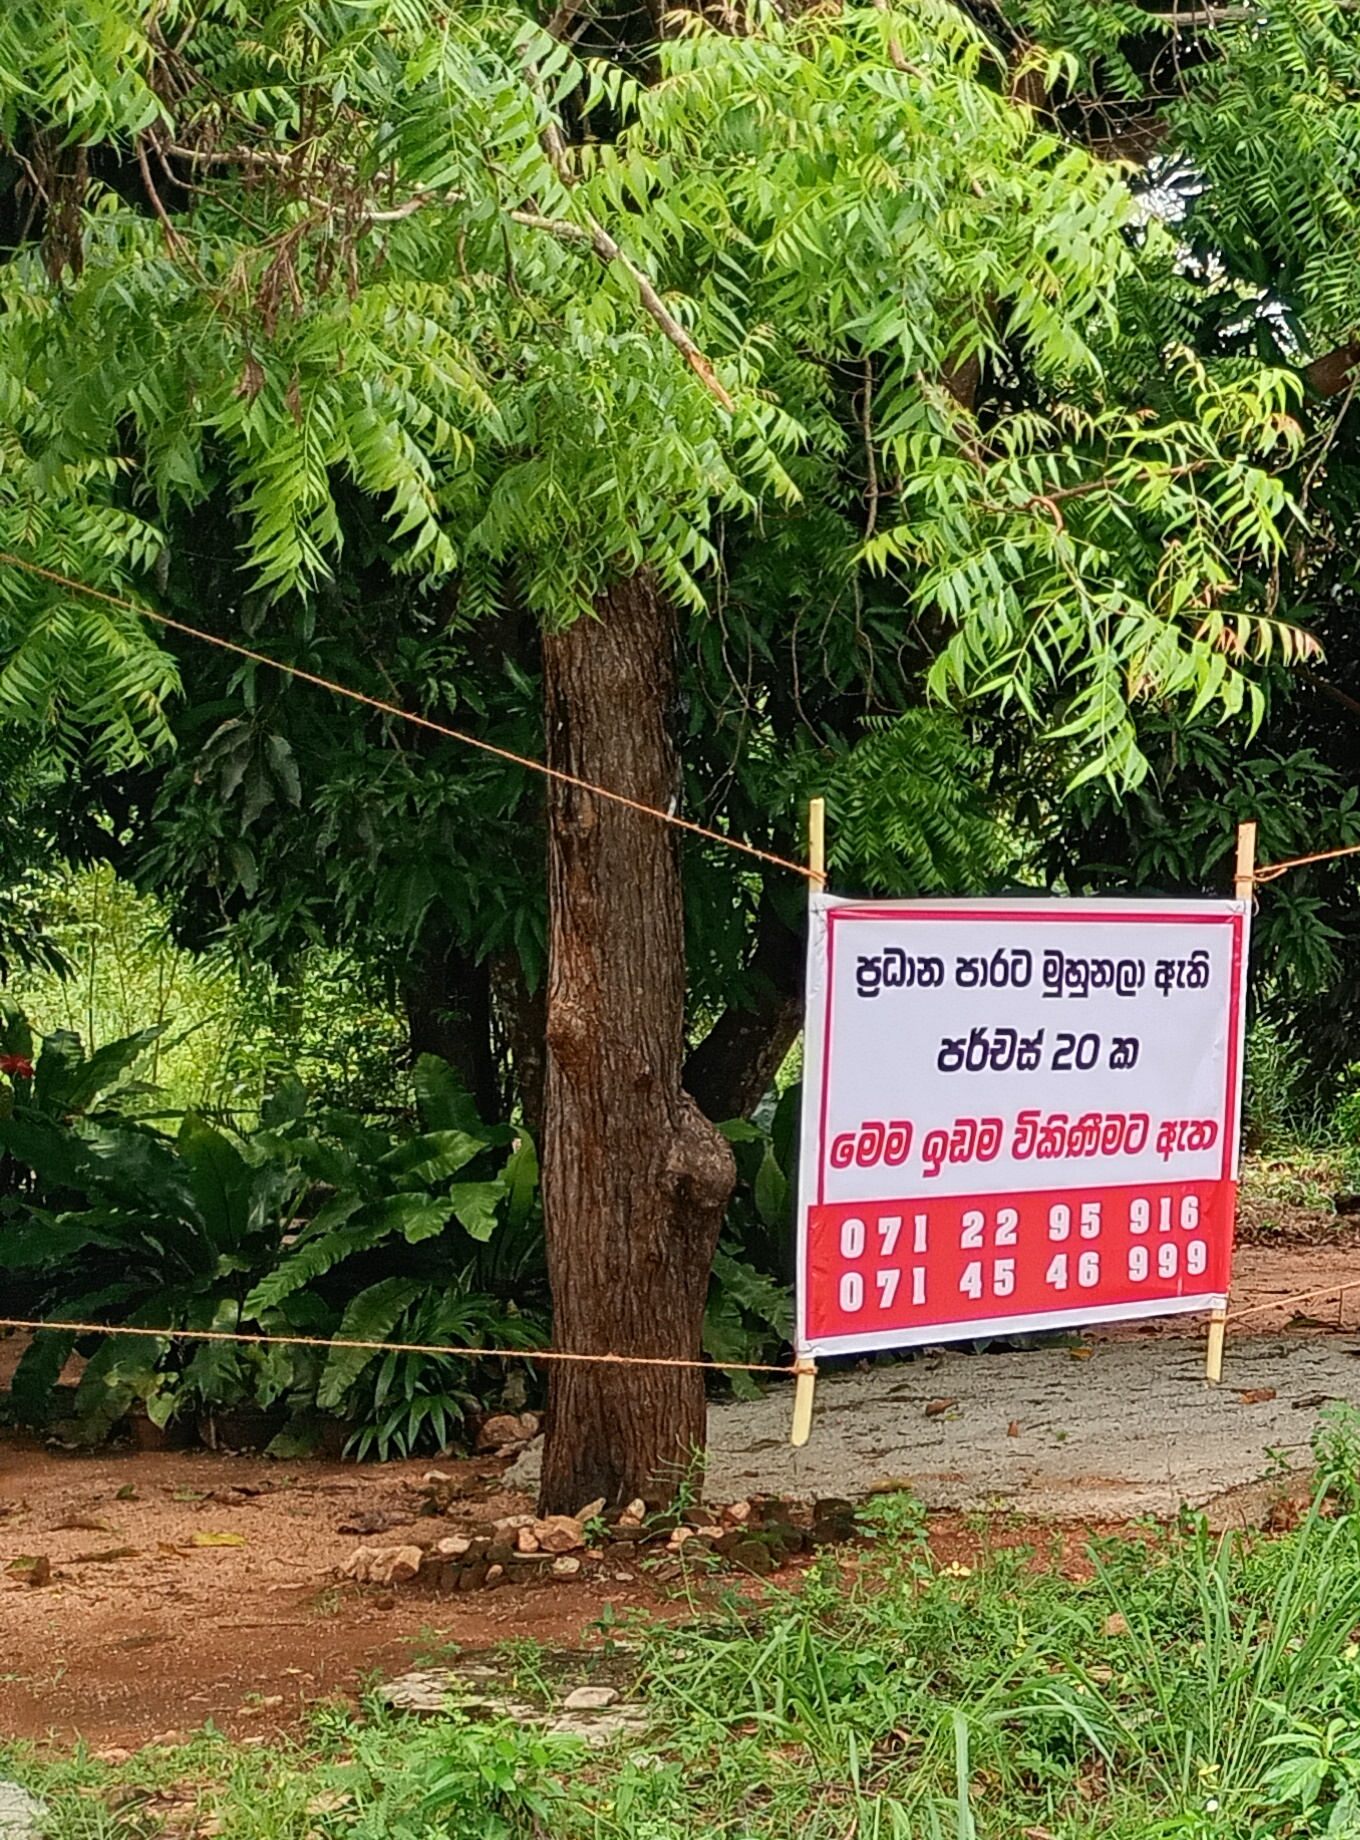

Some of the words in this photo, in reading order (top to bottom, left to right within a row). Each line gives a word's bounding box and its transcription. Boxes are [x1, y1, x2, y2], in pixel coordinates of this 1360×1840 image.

[856, 947, 945, 998] ප්‍රධාන
[955, 947, 1033, 988] පාරට
[1042, 949, 1146, 999] මුහුනලා
[1154, 950, 1210, 998] ඇති
[937, 1027, 1045, 1072] පර්චස්
[1051, 1033, 1101, 1071] 20
[1109, 1037, 1139, 1070] ක
[830, 1120, 913, 1169] මෙම
[922, 1118, 1003, 1178] ඉඩම
[1156, 1120, 1219, 1162] ඇත
[839, 1213, 927, 1259] 071
[960, 1207, 1019, 1250] 22
[1048, 1202, 1101, 1242] 95
[1129, 1195, 1200, 1234] 916
[838, 1266, 926, 1312] 071
[958, 1258, 1016, 1300] 45
[1045, 1251, 1101, 1290] 46
[1127, 1240, 1207, 1282] 999
